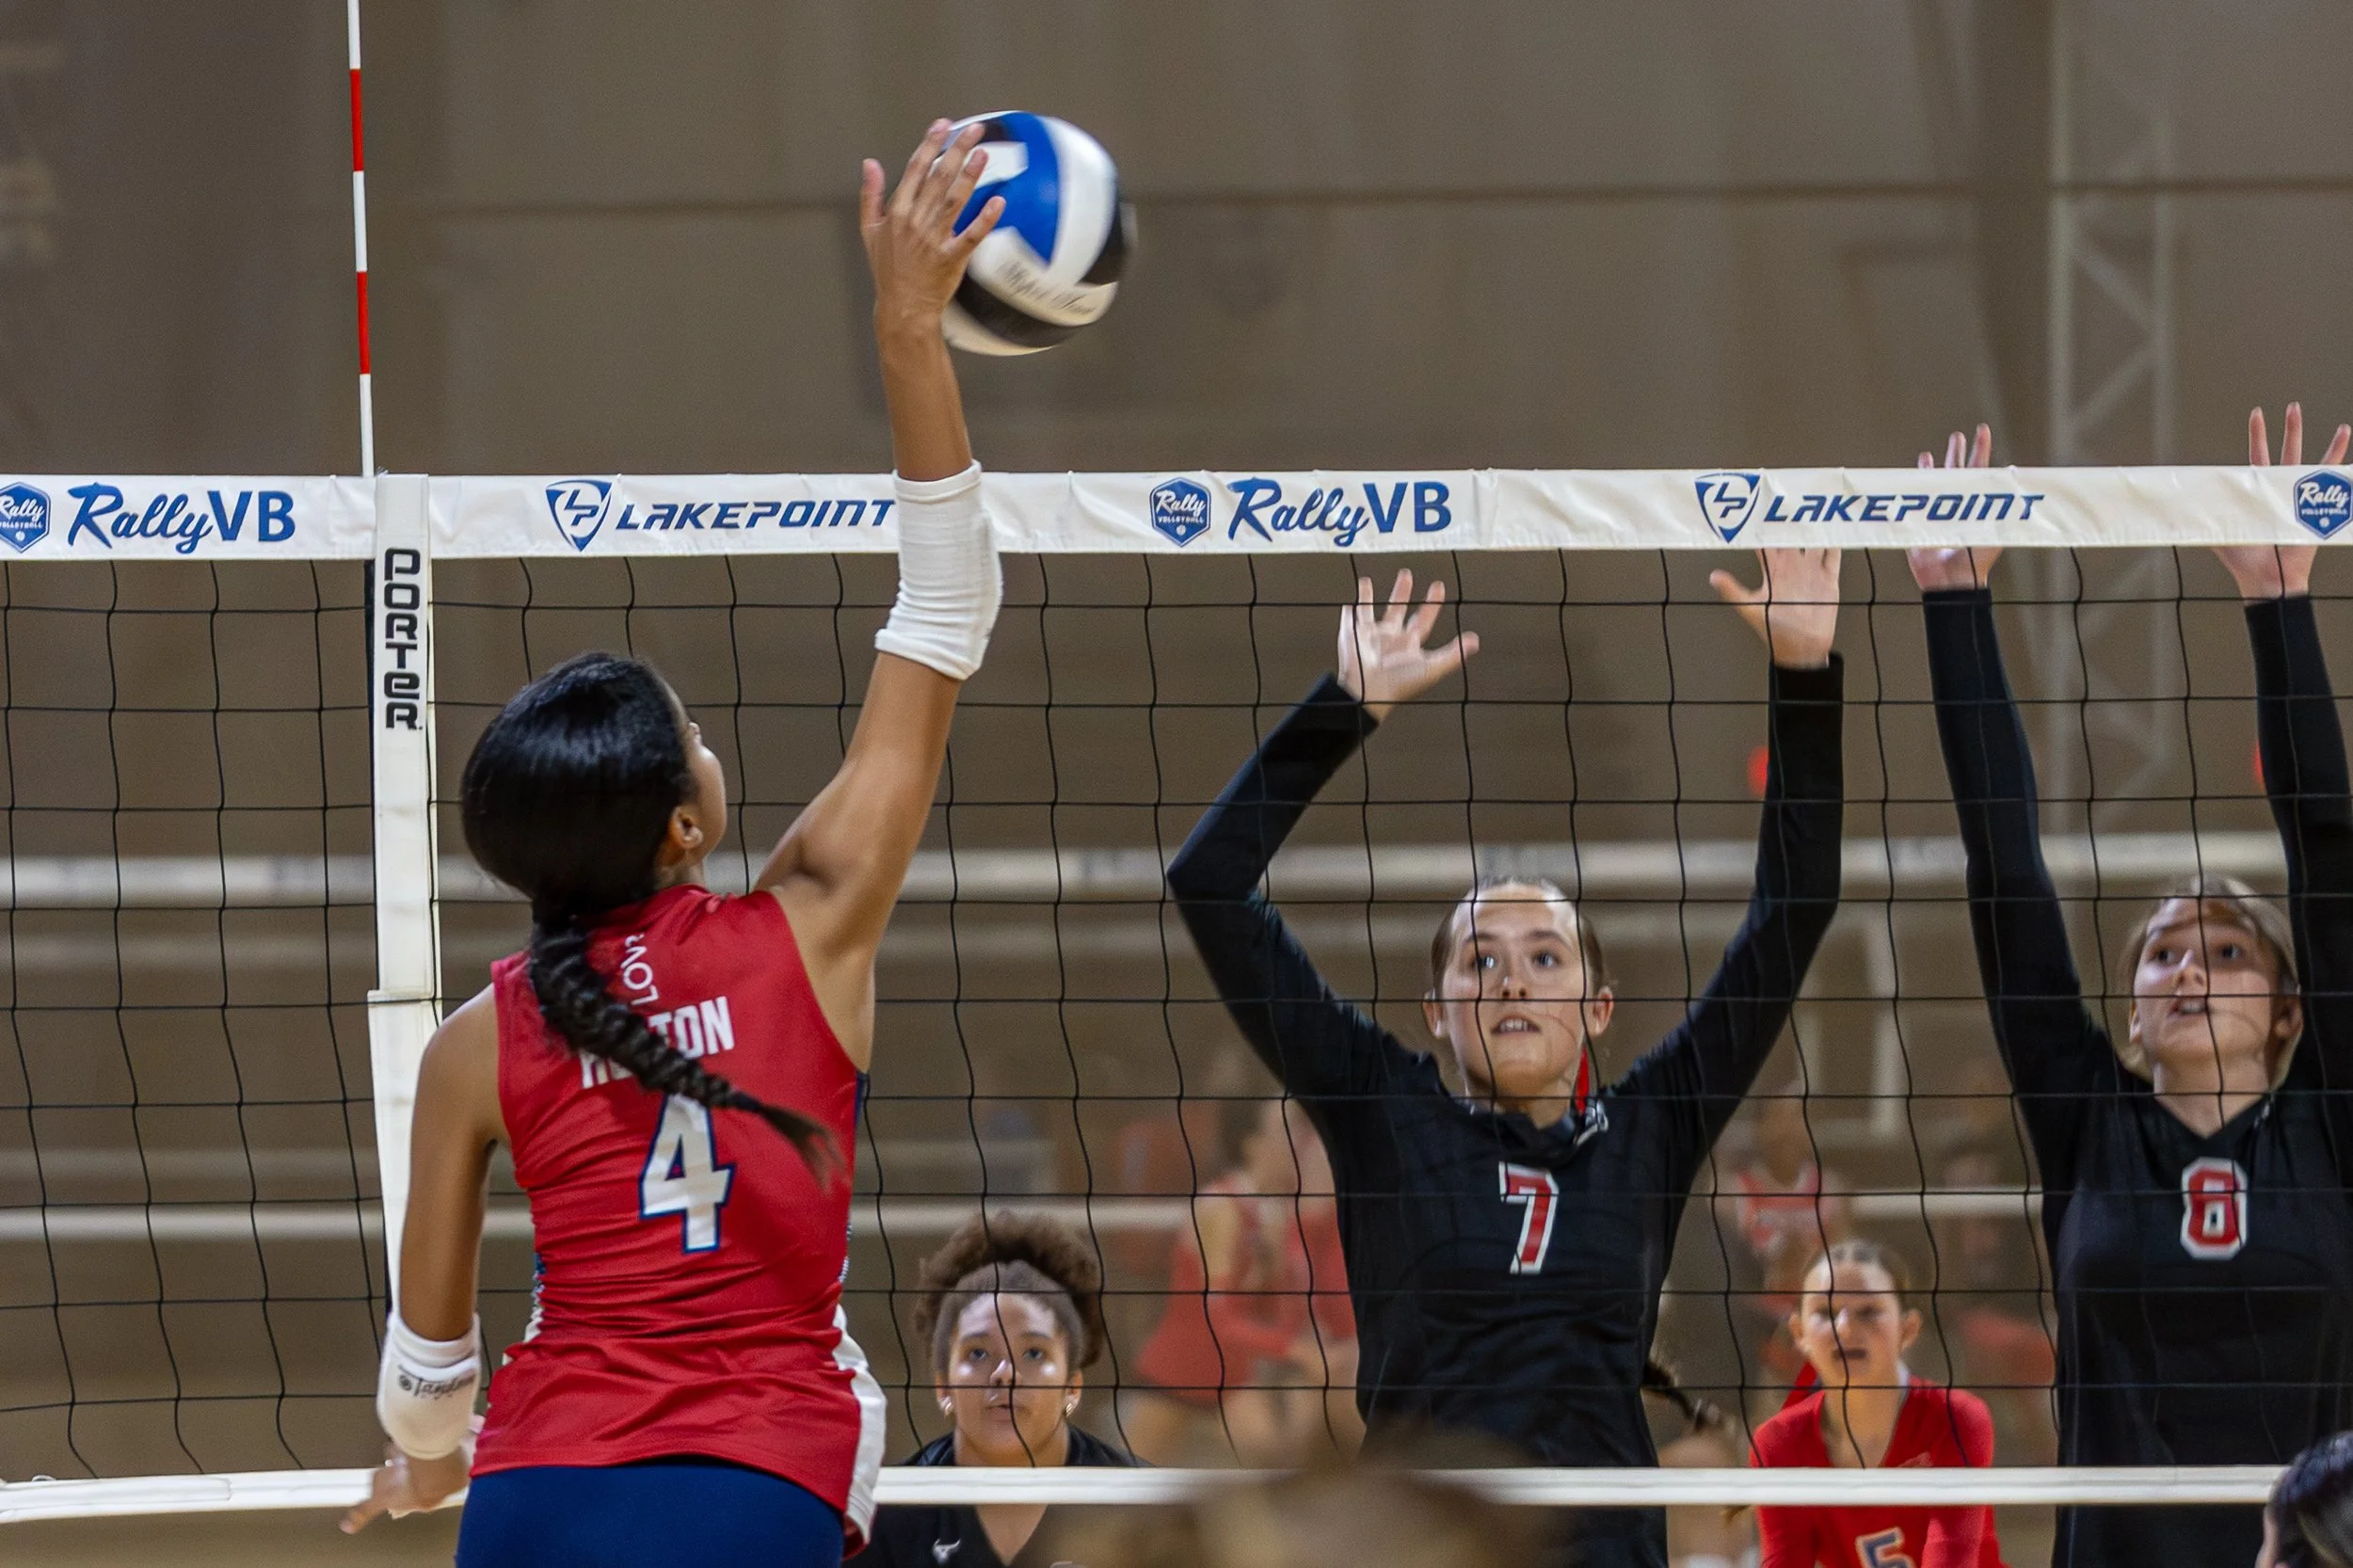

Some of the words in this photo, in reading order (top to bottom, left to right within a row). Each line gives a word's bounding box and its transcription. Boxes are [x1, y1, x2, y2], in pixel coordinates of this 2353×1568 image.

[1156, 489, 1207, 517] Rally
[1763, 493, 2045, 522] LAKEPOINT
[2298, 481, 2350, 508] Rally
[615, 499, 897, 530] LAKEPOINT
[638, 1093, 736, 1254] 4
[1498, 1160, 1560, 1274] 7
